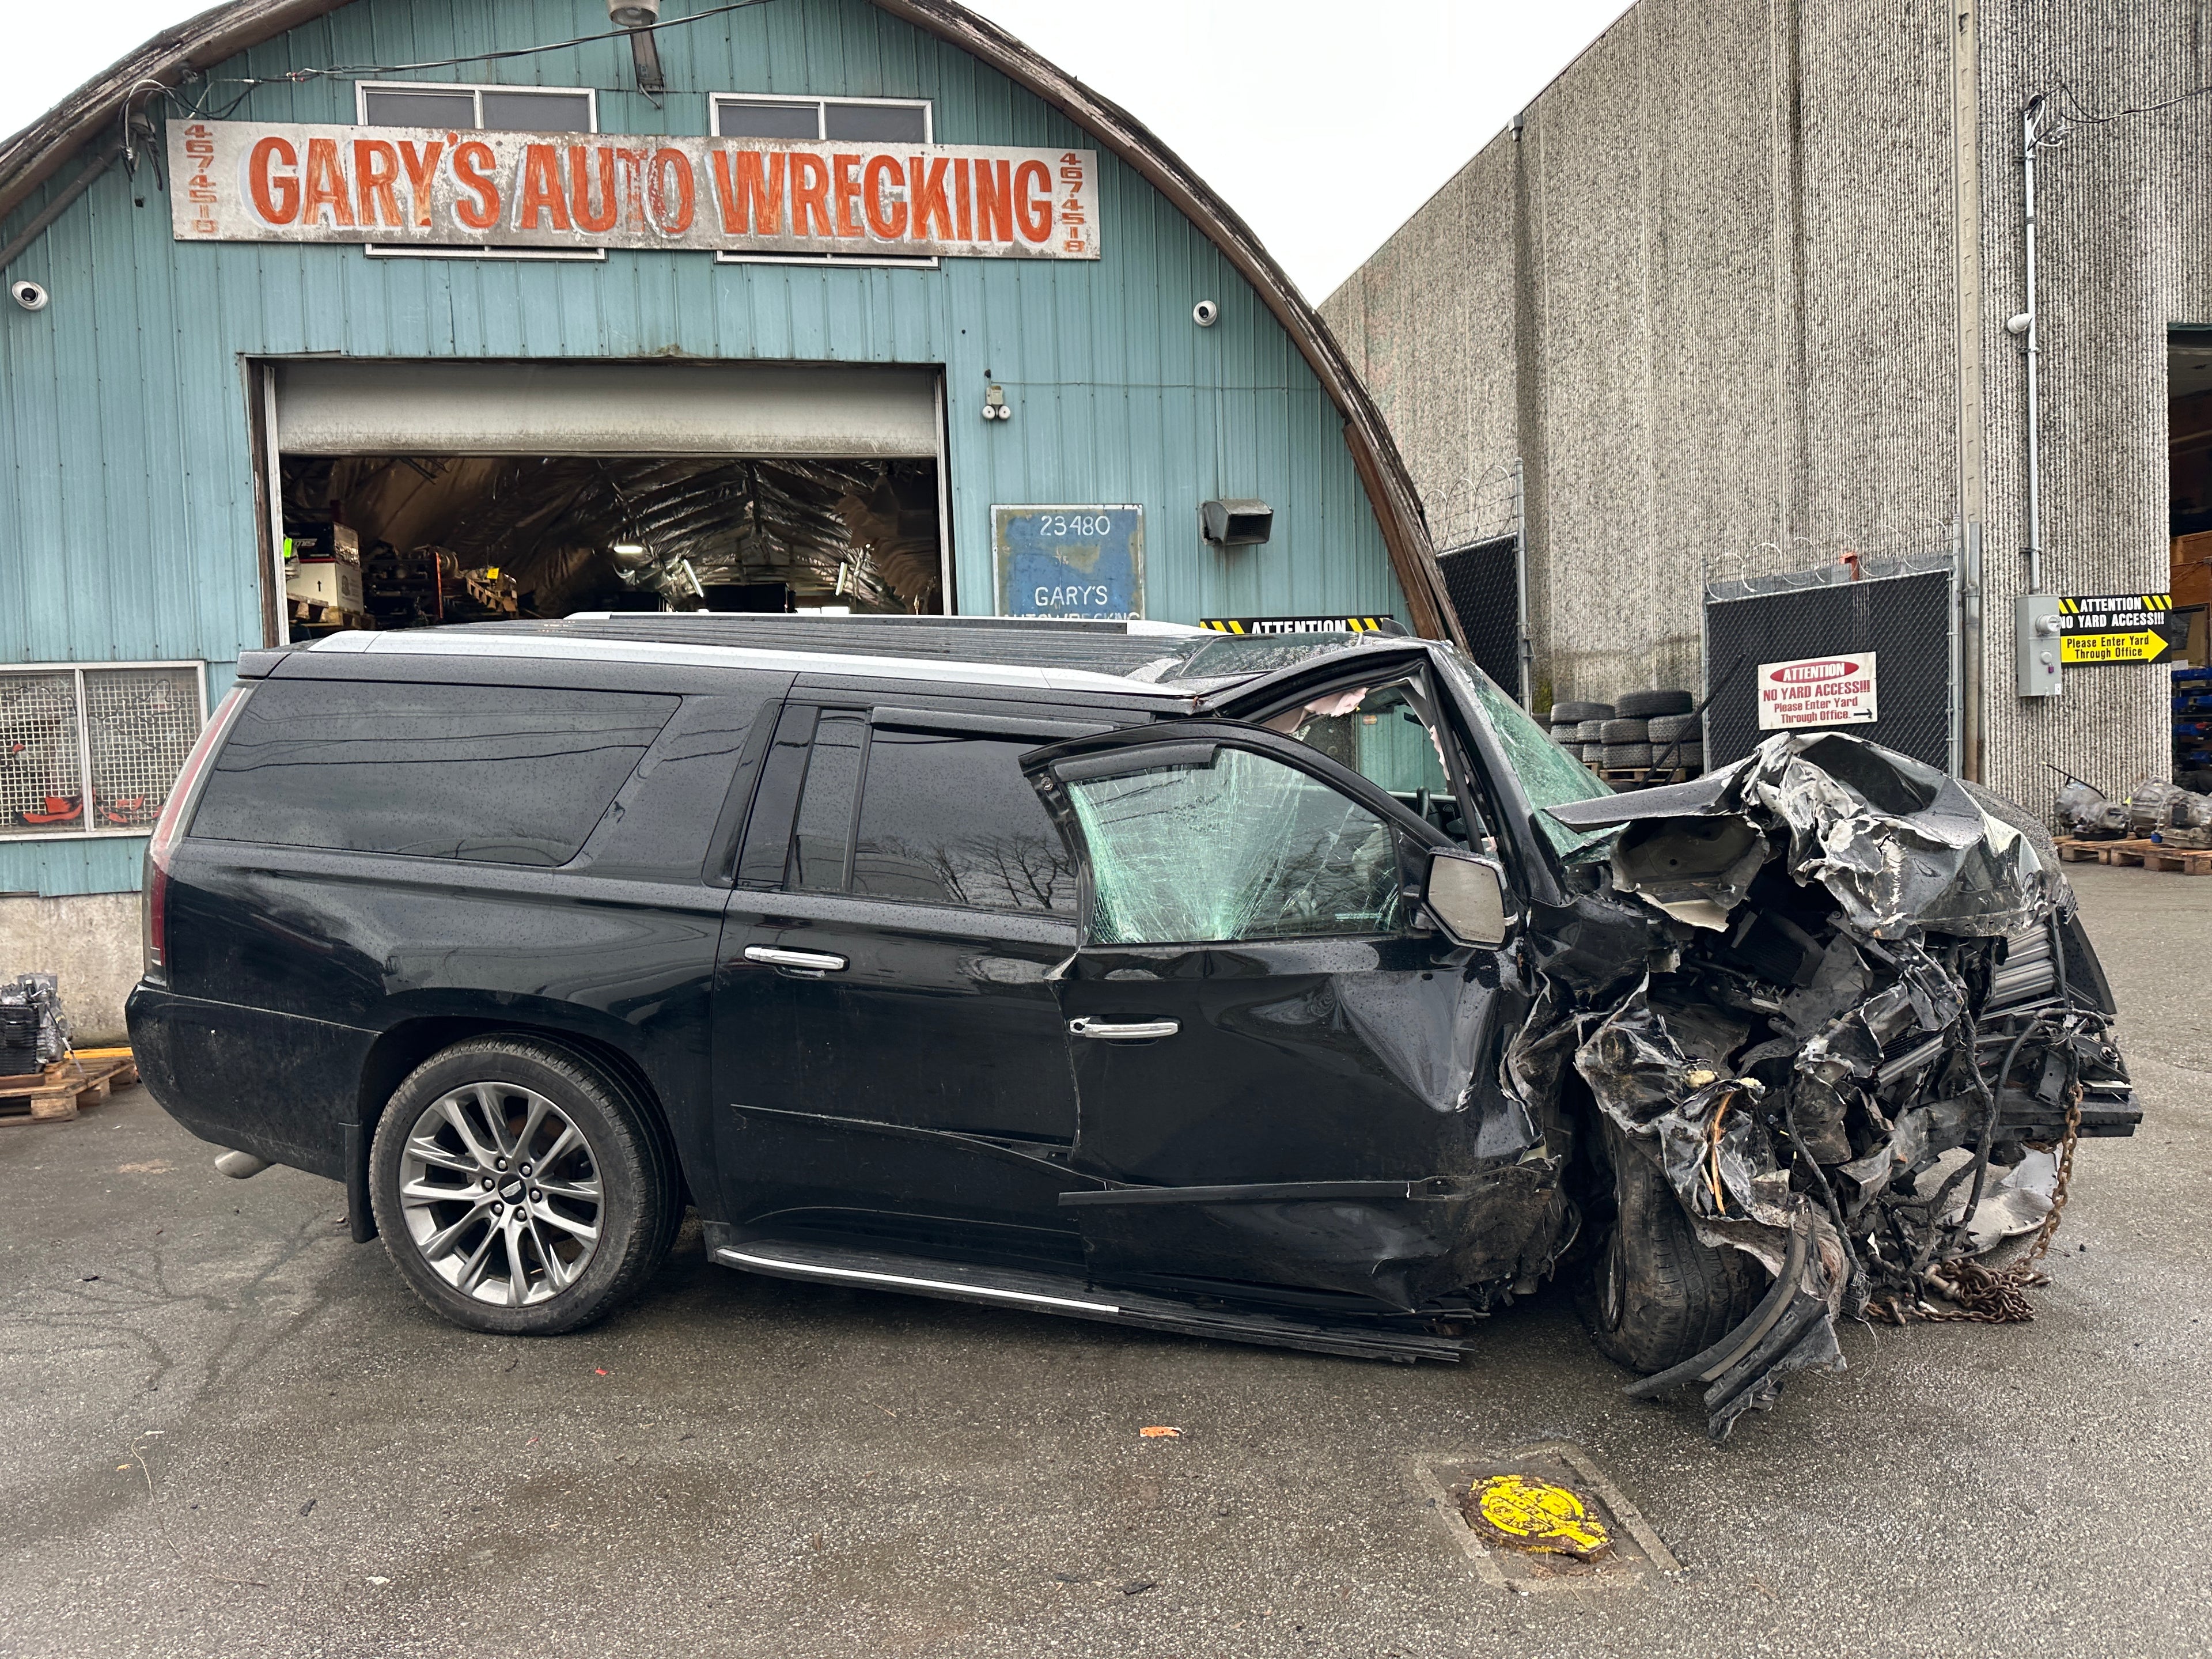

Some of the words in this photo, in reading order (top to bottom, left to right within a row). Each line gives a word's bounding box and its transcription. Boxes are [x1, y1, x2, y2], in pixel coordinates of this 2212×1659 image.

[249, 132, 501, 230] GARY'S
[521, 144, 695, 234] AUTO
[712, 150, 1052, 243] WRECKING
[1040, 515, 1111, 536] 23480
[1035, 585, 1108, 607] GARY'S
[2080, 597, 2142, 612] ATTENTION
[1251, 620, 1347, 634] ATTENTION
[2078, 614, 2107, 628] YARD
[2111, 612, 2164, 627] ACCESS!!!
[2067, 638, 2097, 648] Please
[2101, 637, 2126, 647] Enter
[2129, 635, 2149, 645] Yard
[2074, 649, 2111, 660] Through
[2115, 647, 2142, 657] Office
[1783, 662, 1845, 681] ATTENTION
[1763, 688, 1778, 702] NO
[1781, 685, 1812, 700] YARD
[1815, 680, 1870, 697] ACCESS!!!
[1774, 702, 1802, 713] Please
[1805, 700, 1831, 710] Enter
[1834, 696, 1858, 707] Yard
[1781, 712, 1817, 724] Through
[1820, 710, 1851, 721] Office.
